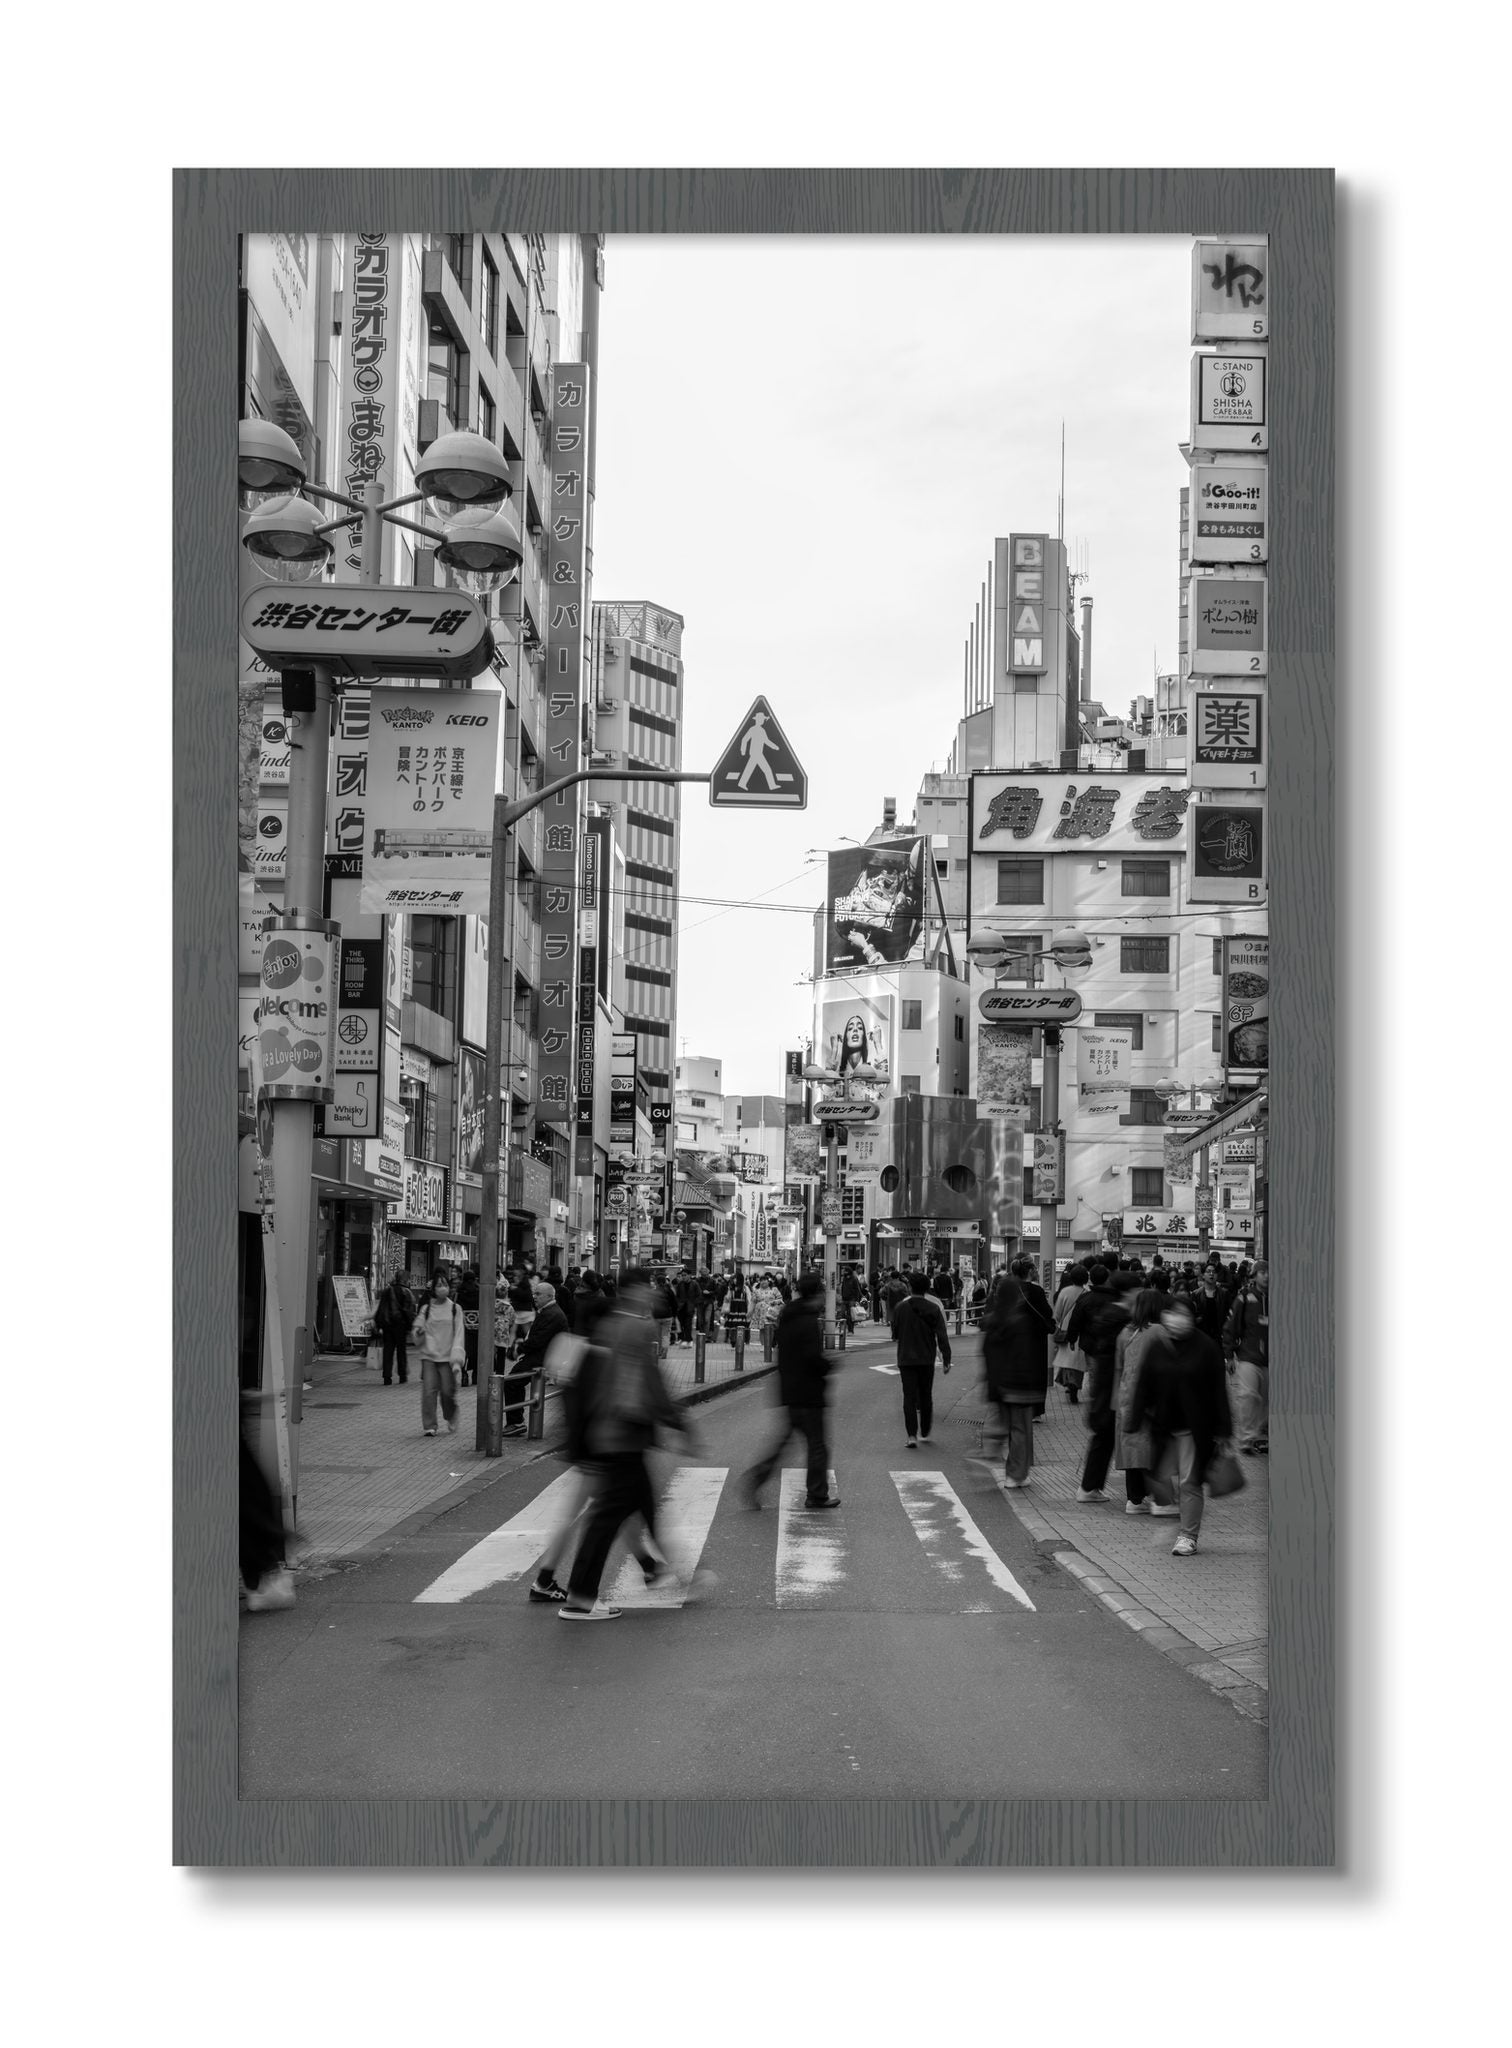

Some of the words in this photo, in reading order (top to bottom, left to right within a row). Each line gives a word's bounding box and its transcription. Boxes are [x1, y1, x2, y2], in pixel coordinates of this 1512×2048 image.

[352, 245, 389, 366] カラオケ
[1252, 320, 1263, 334] 5
[1213, 362, 1253, 371] C.STAND
[1213, 398, 1253, 408] SHISHA
[1211, 485, 1260, 499] Goo-it!
[1201, 524, 1261, 535] 全身もみほぐし
[1250, 545, 1261, 558] 3
[1014, 537, 1044, 667] BEAM
[252, 602, 472, 635] 渋谷センター街
[1250, 658, 1260, 670] 2
[446, 715, 489, 726] KEIO
[1205, 700, 1250, 745] 薬
[1199, 747, 1254, 760] マツモトキヨシ
[397, 746, 411, 784] 冒険へ
[263, 771, 286, 779] 渋谷店
[413, 746, 429, 812] カントーの
[450, 747, 465, 800] 京王線で
[1250, 771, 1258, 785] 1
[979, 785, 1189, 839] 角海老
[1200, 819, 1253, 863] 一蘭
[586, 838, 594, 869] kimono
[260, 865, 282, 873] 渋谷店
[386, 890, 464, 902] 渋谷センター街
[585, 874, 594, 904] hearts
[1249, 884, 1258, 898] B
[263, 951, 299, 982] Enjoy
[539, 887, 571, 1103] カラオケ館
[260, 995, 328, 1018] Welcome
[985, 997, 1076, 1009] 渋谷センター街
[1228, 1005, 1255, 1023] 6F
[274, 1047, 301, 1066] Lovely
[334, 1105, 364, 1116] Whisky
[653, 1108, 670, 1118] GU
[816, 1106, 871, 1114] 渋谷センター街
[334, 1114, 352, 1122] Bank
